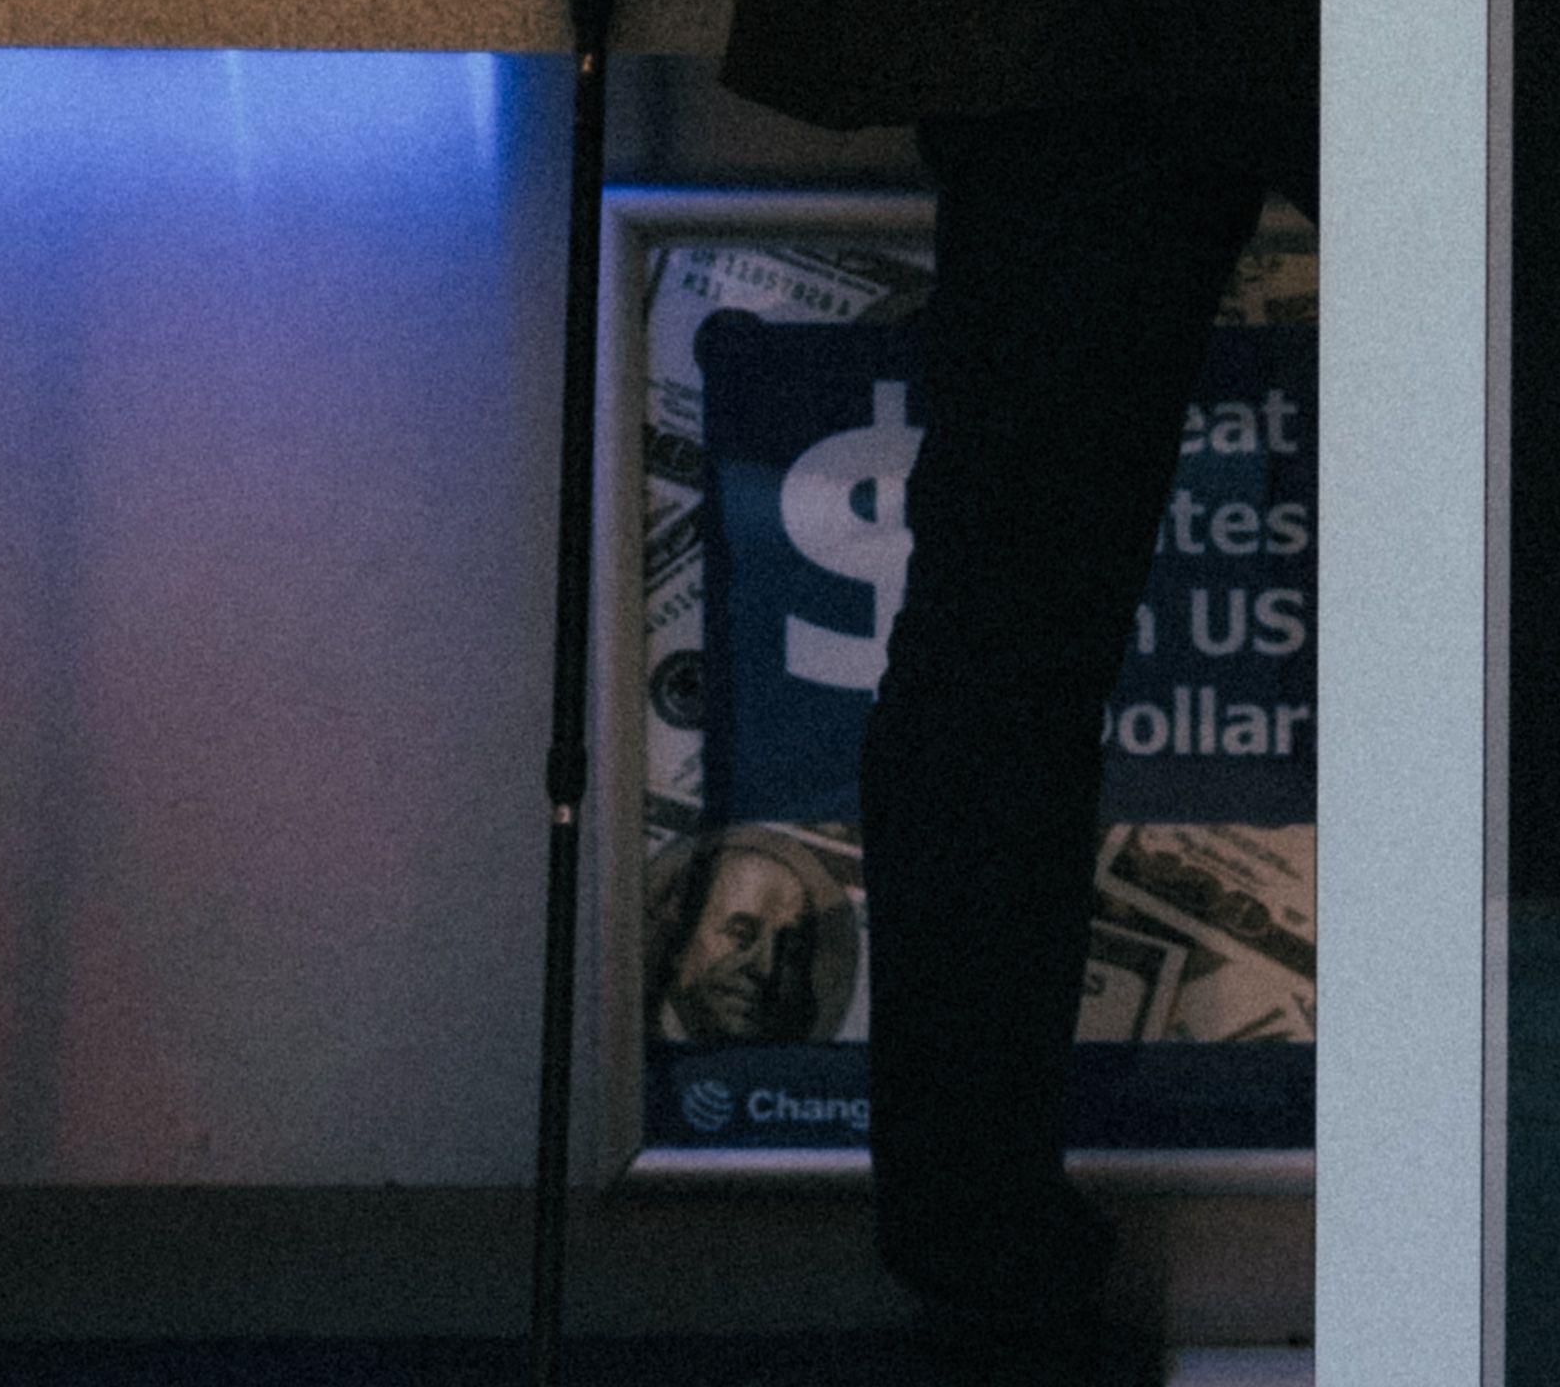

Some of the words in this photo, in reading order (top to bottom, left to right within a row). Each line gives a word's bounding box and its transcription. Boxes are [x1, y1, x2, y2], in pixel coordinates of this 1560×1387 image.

[1180, 389, 1298, 455] eat
[1156, 489, 1310, 555] tes
[1190, 587, 1308, 657] US
[1101, 685, 1311, 756] ollar
[746, 1087, 870, 1131] Chang
